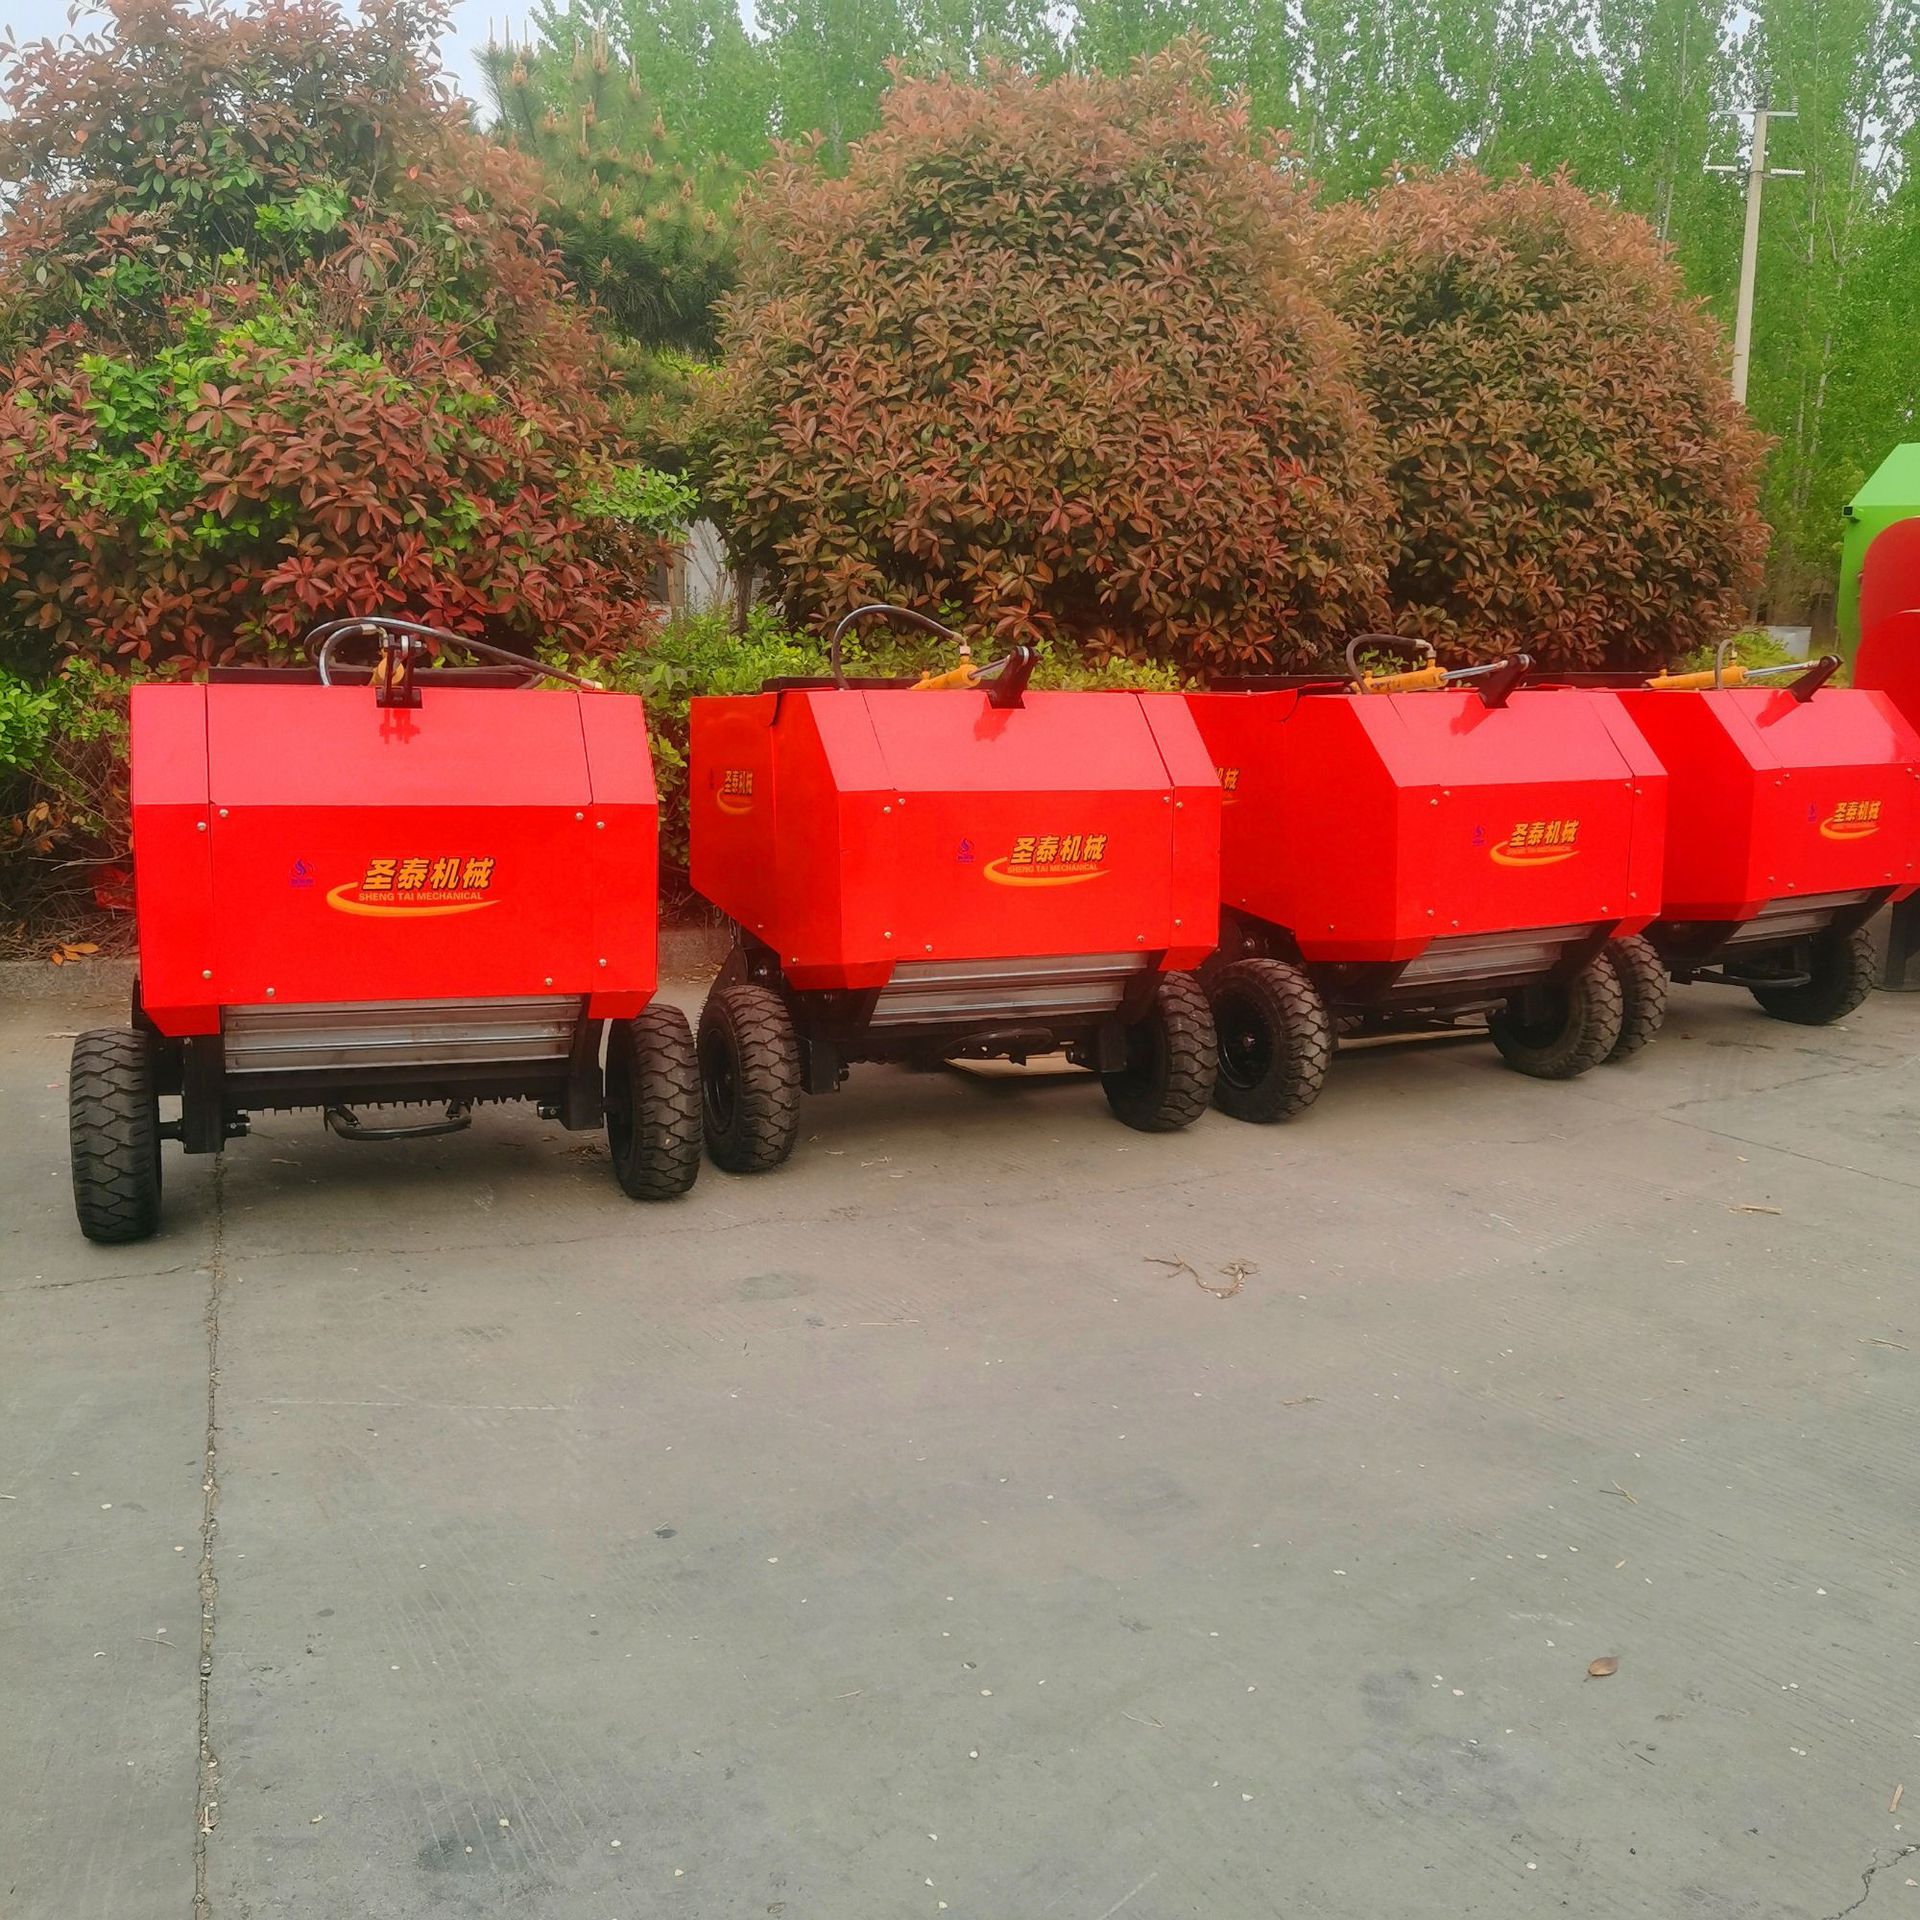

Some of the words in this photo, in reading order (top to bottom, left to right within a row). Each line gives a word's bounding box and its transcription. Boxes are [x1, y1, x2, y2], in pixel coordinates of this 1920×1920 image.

[1509, 820, 1579, 846] 圣泰机械
[1010, 834, 1107, 864] 圣泰机械
[362, 857, 495, 890] 圣泰机械
[358, 892, 395, 901] SHENG
[398, 892, 414, 901] TAI
[417, 891, 482, 900] MECHANICAL
